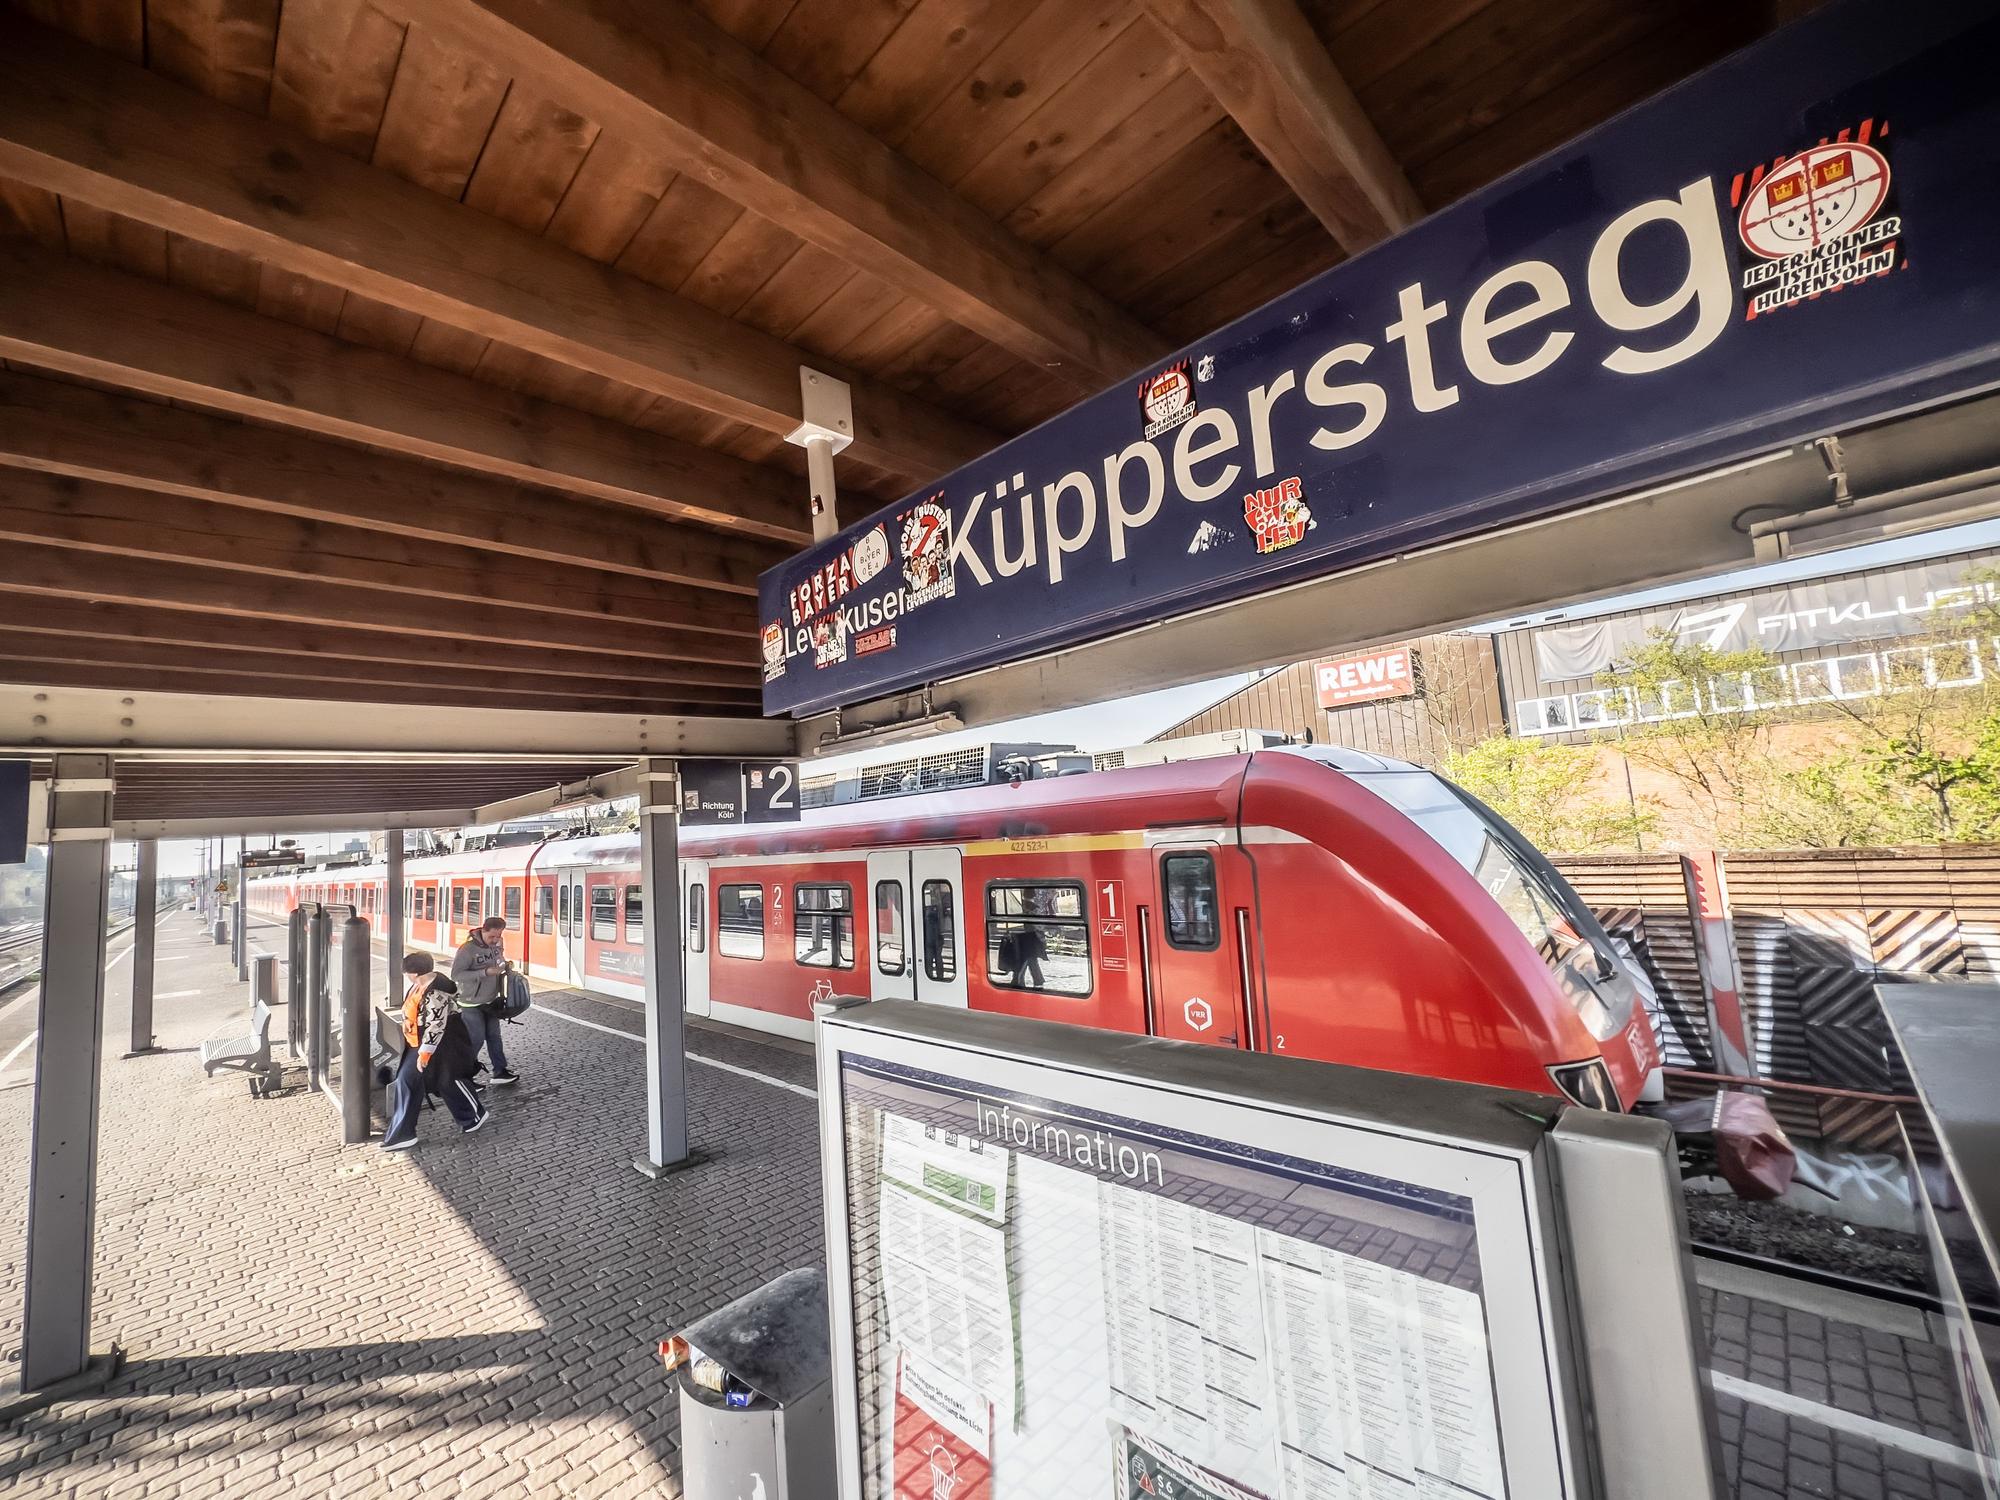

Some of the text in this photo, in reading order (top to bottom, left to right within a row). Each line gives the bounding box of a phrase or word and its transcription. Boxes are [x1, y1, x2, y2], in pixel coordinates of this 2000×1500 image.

[1745, 218, 1898, 286] JEDER KÖLNER
[1783, 251, 1858, 288] IST EIN
[1756, 252, 1892, 311] HURENSOHN
[945, 176, 1734, 599] Küppersteg
[1244, 477, 1302, 513] NUR
[789, 553, 851, 610] FORZA
[791, 575, 850, 628] BAYER
[1319, 653, 1407, 691] REWE
[768, 765, 793, 809] 2
[702, 801, 734, 810] Richtung
[718, 811, 734, 819] Köln
[1010, 841, 1025, 852] 422
[773, 886, 782, 909] 2
[1102, 883, 1116, 918] 1
[1190, 1010, 1206, 1019] VRR
[1276, 1035, 1285, 1049] 2
[977, 1099, 1164, 1187] Information
[1165, 1481, 1174, 1494] 6
